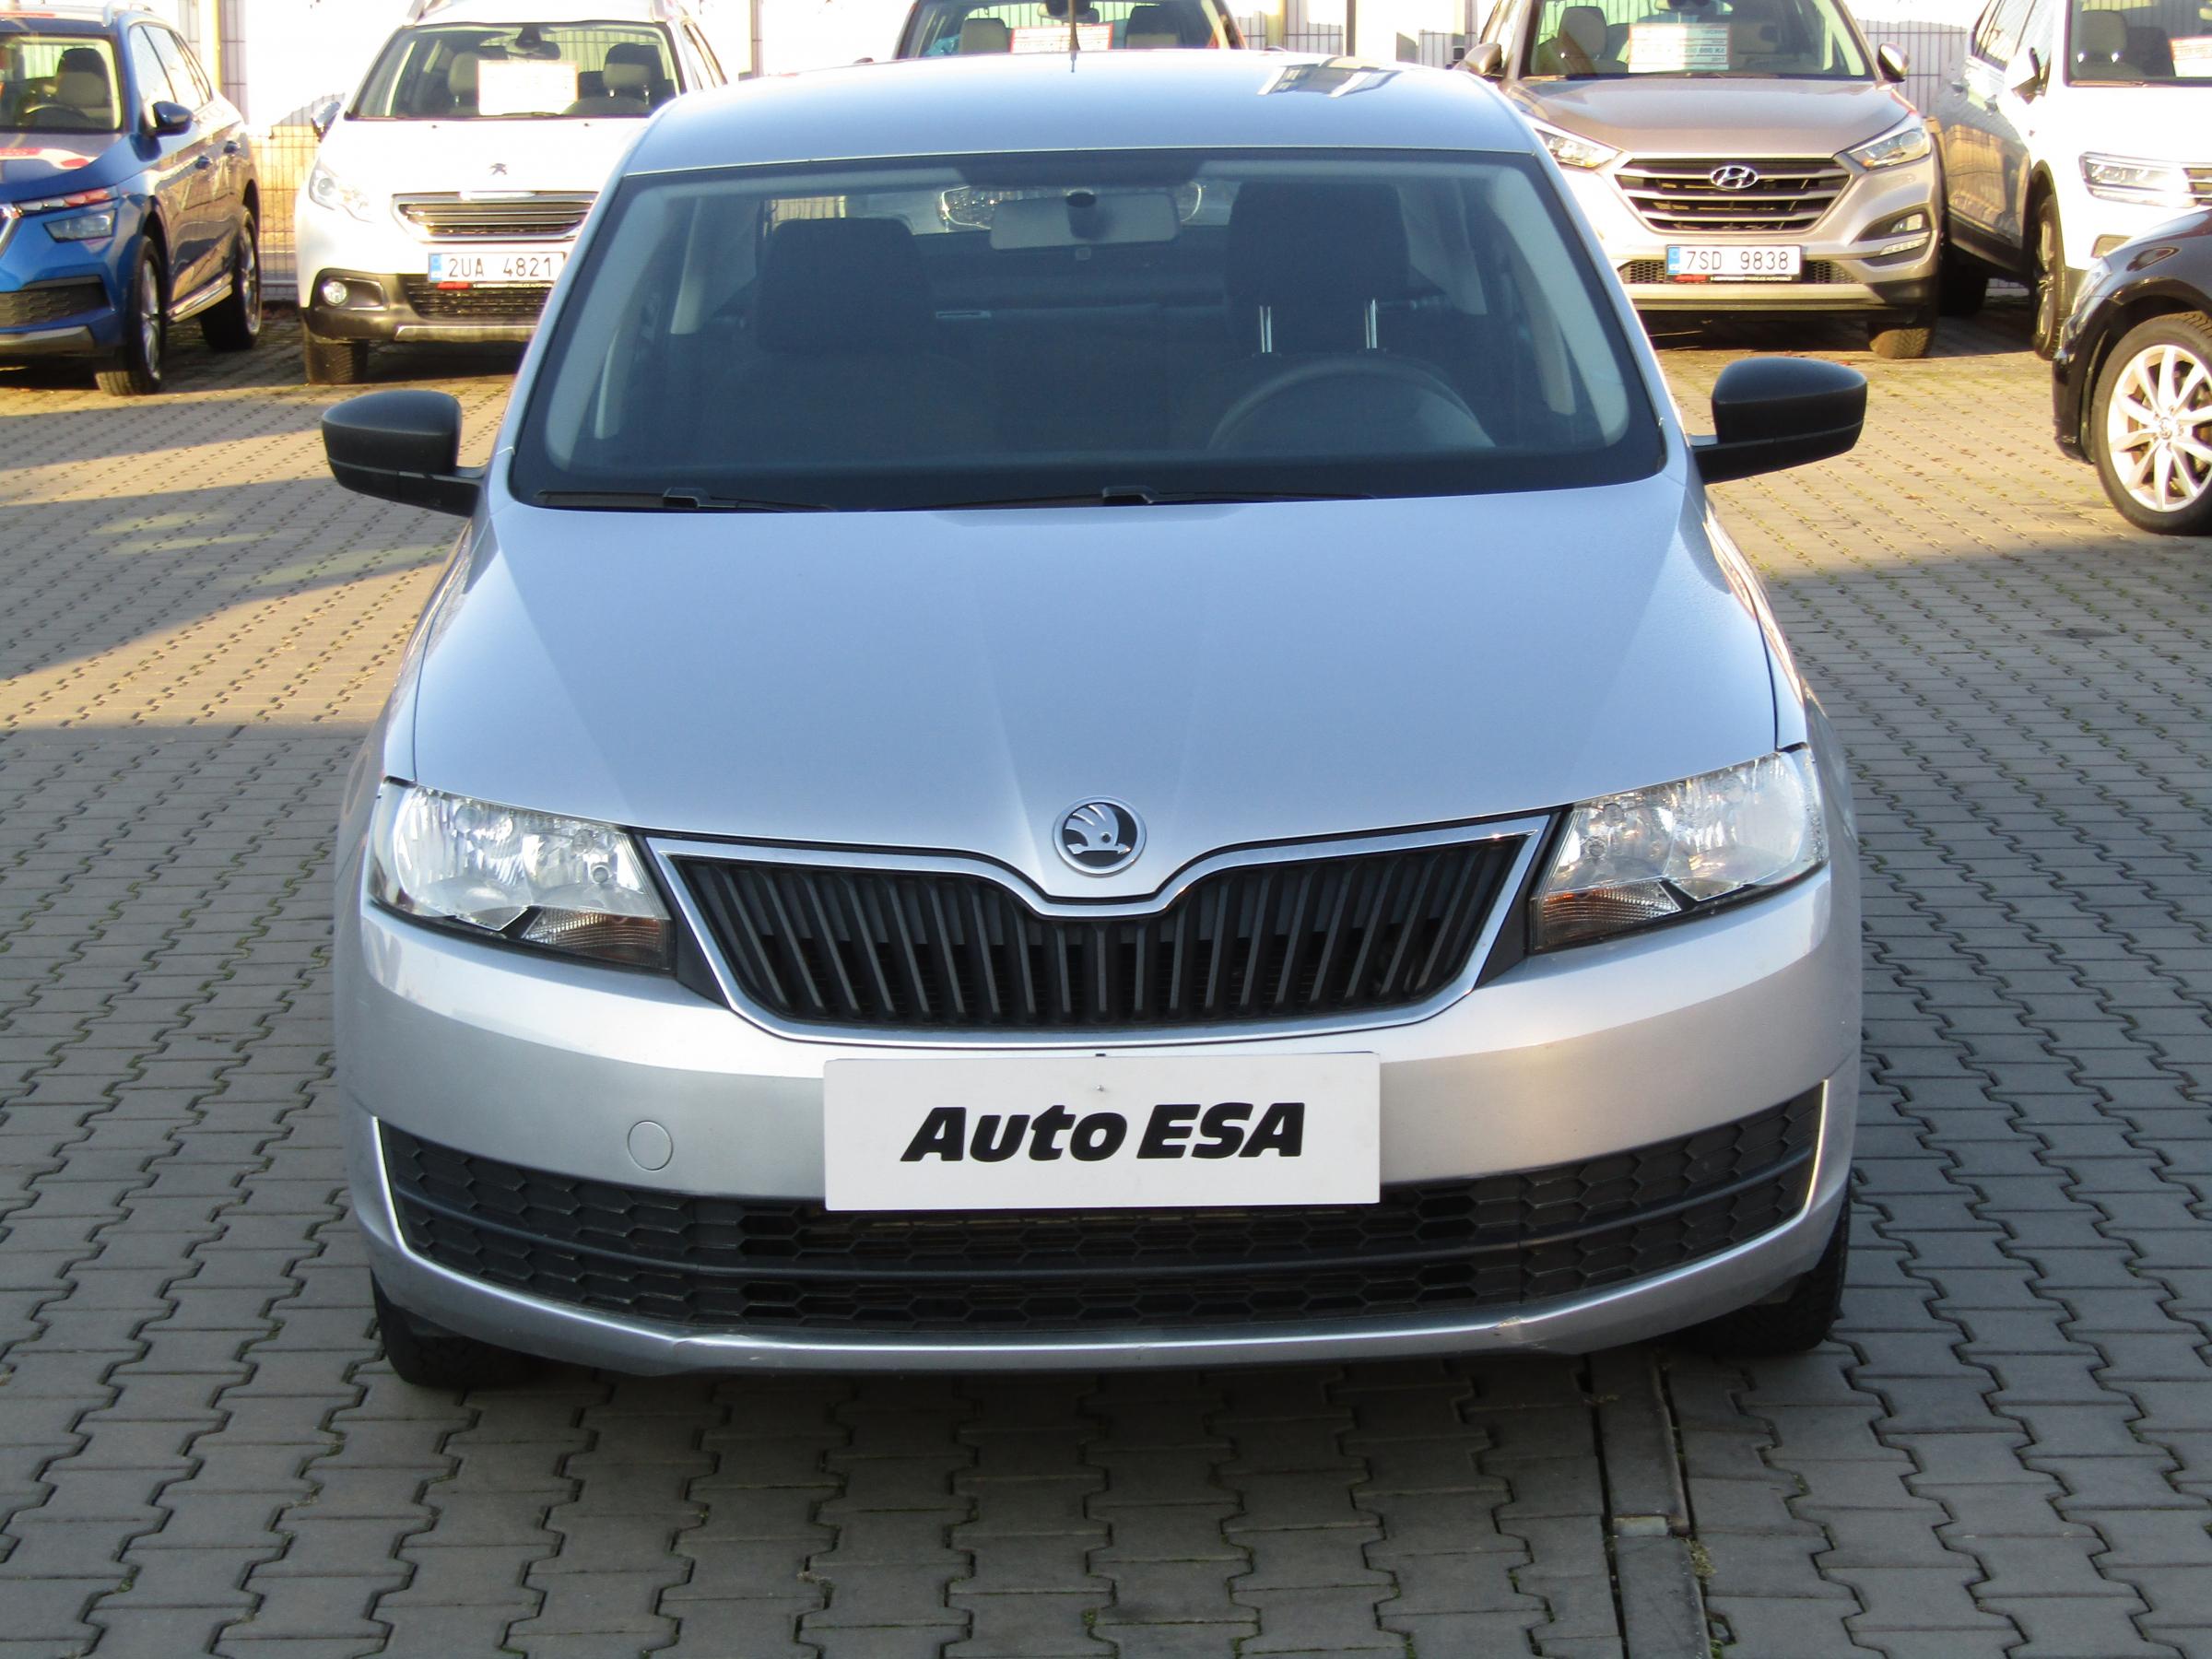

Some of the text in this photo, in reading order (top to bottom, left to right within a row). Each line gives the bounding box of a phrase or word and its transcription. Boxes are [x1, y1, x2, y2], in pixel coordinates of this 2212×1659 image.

[448, 257, 552, 277] 2UA 4821
[1687, 251, 1789, 270] 7SD 9838
[900, 1102, 1306, 1163] Auto ESA
